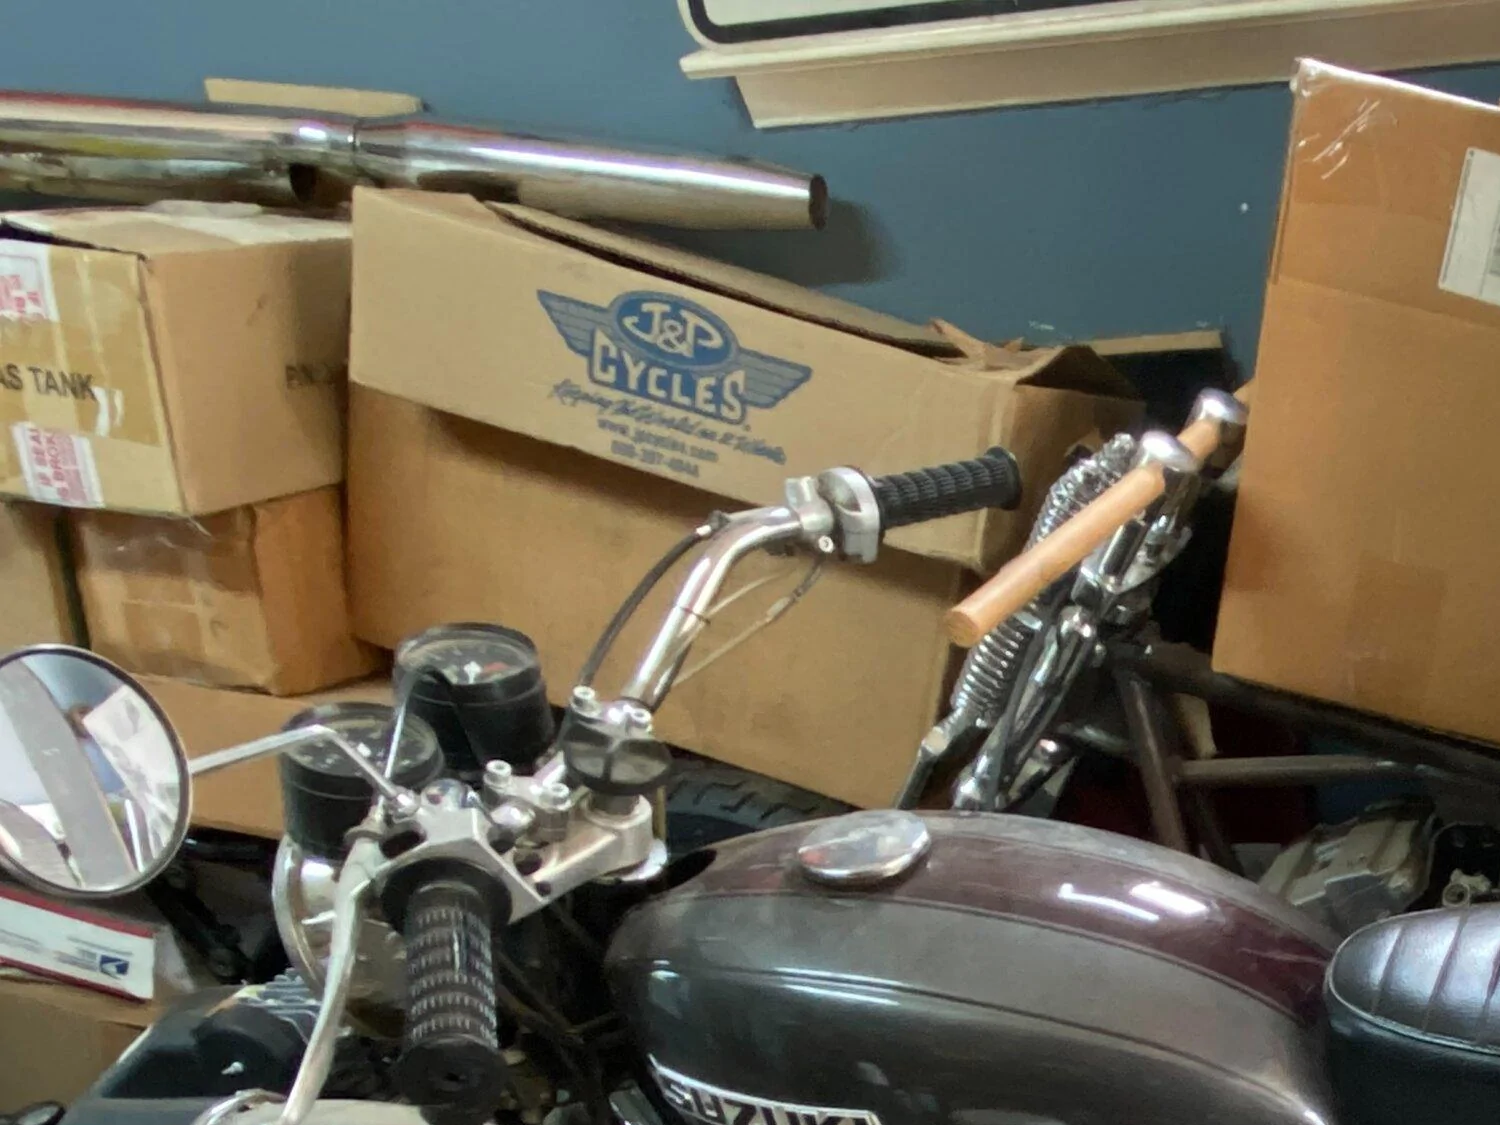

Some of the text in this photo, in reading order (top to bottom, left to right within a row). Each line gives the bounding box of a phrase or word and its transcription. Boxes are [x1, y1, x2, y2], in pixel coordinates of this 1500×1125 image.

[622, 301, 724, 358] J&P
[28, 366, 98, 401] TANK
[593, 326, 746, 422] CYCLES
